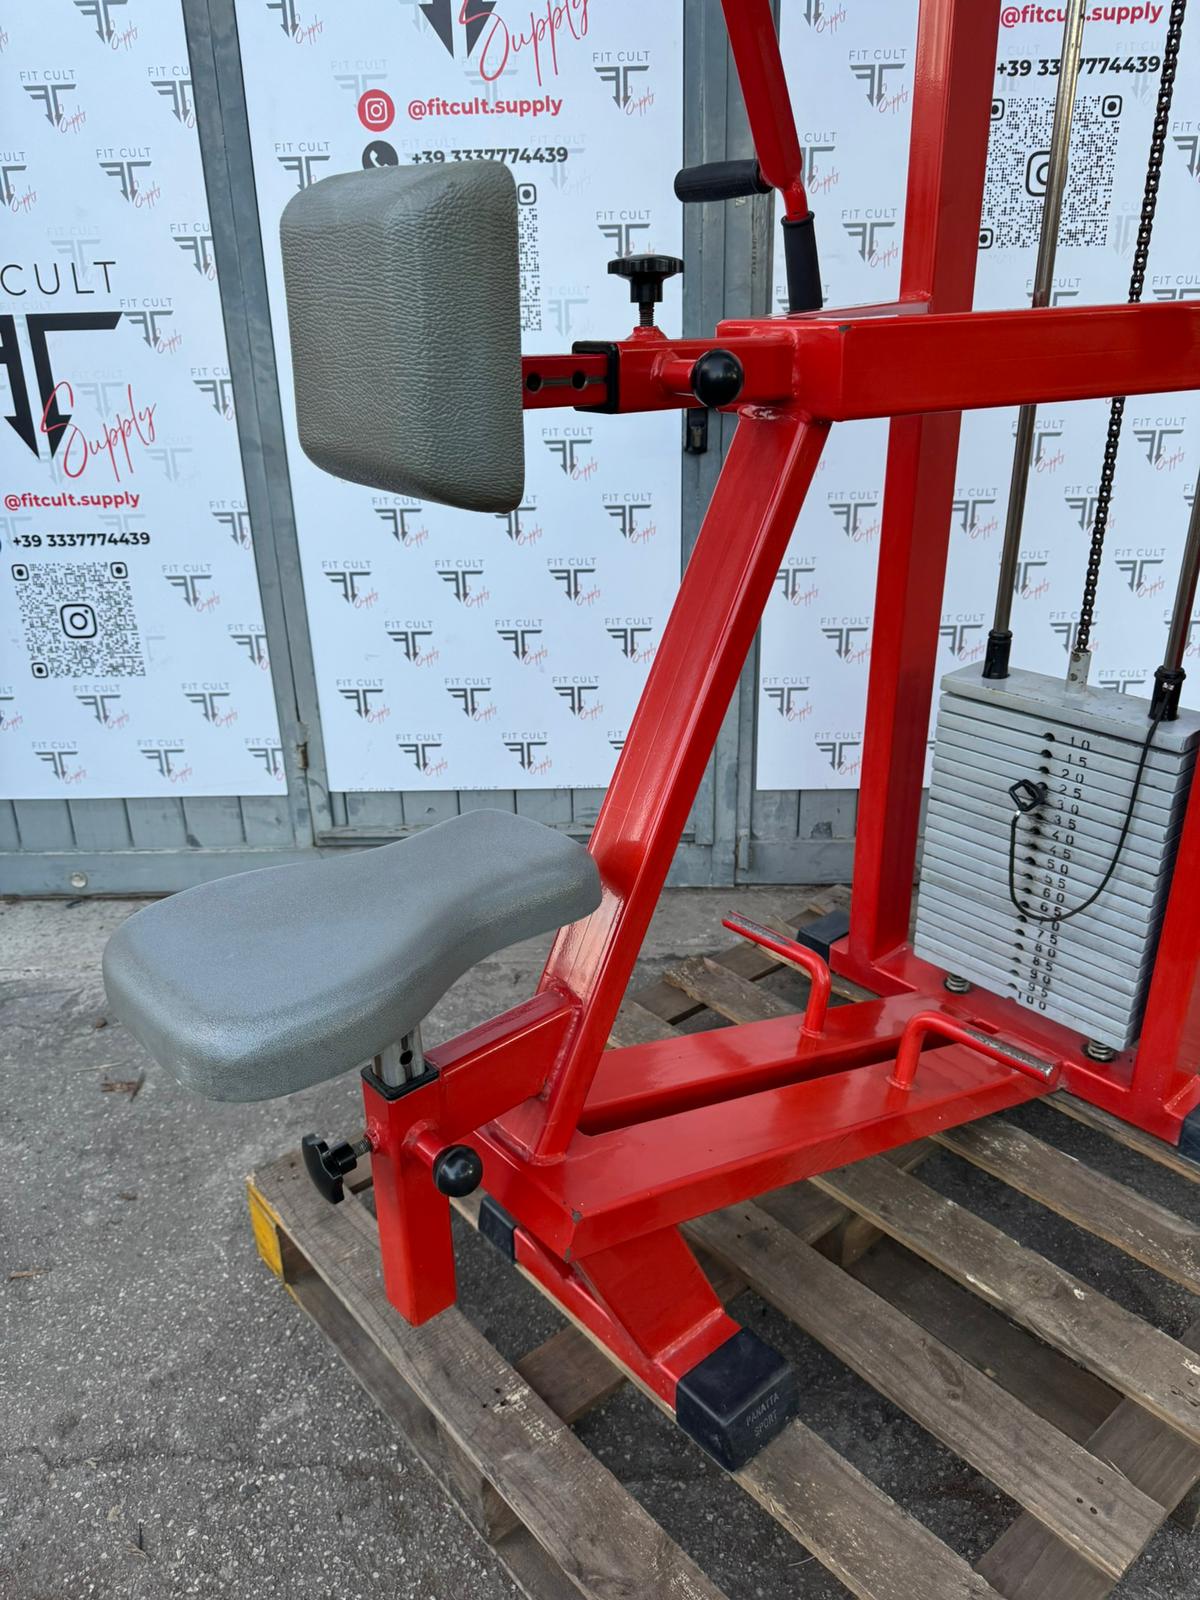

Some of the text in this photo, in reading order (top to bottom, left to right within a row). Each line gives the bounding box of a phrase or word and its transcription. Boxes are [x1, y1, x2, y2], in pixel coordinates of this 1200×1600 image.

[1001, 3, 1163, 27] @fitcu.supply
[592, 50, 649, 63] FIT CULT
[849, 49, 906, 61] FIT CULT
[997, 56, 1160, 75] +39 337774439
[19, 69, 76, 81] FIT CULT
[148, 66, 169, 77] FIT
[408, 96, 563, 120] @fitcult.supply
[1173, 122, 1191, 131] FIT
[805, 133, 837, 143] CULT
[274, 141, 330, 152] FIT CULT
[96, 147, 151, 158] FIT CULT
[412, 146, 568, 163] +39 3337774439
[596, 210, 650, 220] FIT CULT
[841, 208, 897, 219] FIT CULT
[170, 223, 189, 233] FIT
[1, 262, 116, 295] CULT
[1152, 274, 1200, 285] FIT CUL
[120, 298, 172, 308] FIT CULT
[191, 367, 208, 376] FIT
[1132, 417, 1186, 428] FIT CULT
[40, 382, 157, 482] Supply
[542, 427, 592, 437] FIT CULT
[828, 491, 879, 500] FIT CULT
[969, 488, 998, 497] CULT
[1064, 486, 1084, 495] FIT
[4, 492, 140, 510] @fitcult.supply
[372, 497, 390, 506] FIT
[602, 493, 652, 502] FIT CULT
[209, 501, 227, 510] FIT
[12, 533, 150, 548] +39 3337774439
[1021, 550, 1050, 560] CULT
[1115, 548, 1166, 558] FIT CULT
[322, 560, 371, 569] FIT CULT
[435, 559, 484, 568] FIT CULT
[547, 557, 596, 566] FIT CULT
[789, 557, 816, 566] CULT
[162, 564, 212, 573] FIT CULT
[605, 617, 653, 626] FIT CULT
[821, 617, 870, 626] FIT CULT
[956, 614, 985, 623] CULT
[1049, 612, 1068, 621] FIT
[228, 624, 244, 633] FIT
[384, 620, 432, 629] FIT CULT
[495, 619, 542, 628] FIT CULT
[1099, 669, 1147, 678] FIT CULT
[336, 678, 384, 687] FIT CULT
[445, 677, 492, 686] FIT CULT
[552, 676, 599, 685] FIT CULT
[762, 676, 811, 685] FIT CULT
[73, 684, 120, 693] FIT CULT
[181, 682, 229, 691] FIT CULT
[396, 733, 442, 742] FIT CULT
[502, 732, 547, 741] FIT CULT
[607, 731, 623, 739] FIT
[815, 732, 831, 740] FIT
[32, 741, 77, 750] FIT CULT
[137, 739, 184, 748] FIT CULT
[245, 738, 260, 746] FIT
[1069, 737, 1090, 750] 10
[1067, 753, 1088, 768] 15
[1061, 770, 1084, 783] 20
[1059, 785, 1081, 798] 25
[1054, 815, 1077, 830] 35
[1052, 831, 1074, 844] 40
[1050, 846, 1072, 860] 45
[1047, 859, 1068, 874] 50
[1043, 888, 1065, 903] 60
[1040, 903, 1062, 917] 65
[1037, 931, 1058, 945] 75
[1035, 944, 1056, 958] 80
[1033, 956, 1054, 970] 85
[1031, 969, 1051, 984] 90
[1028, 982, 1048, 998] 95
[1017, 992, 1046, 1010] 100
